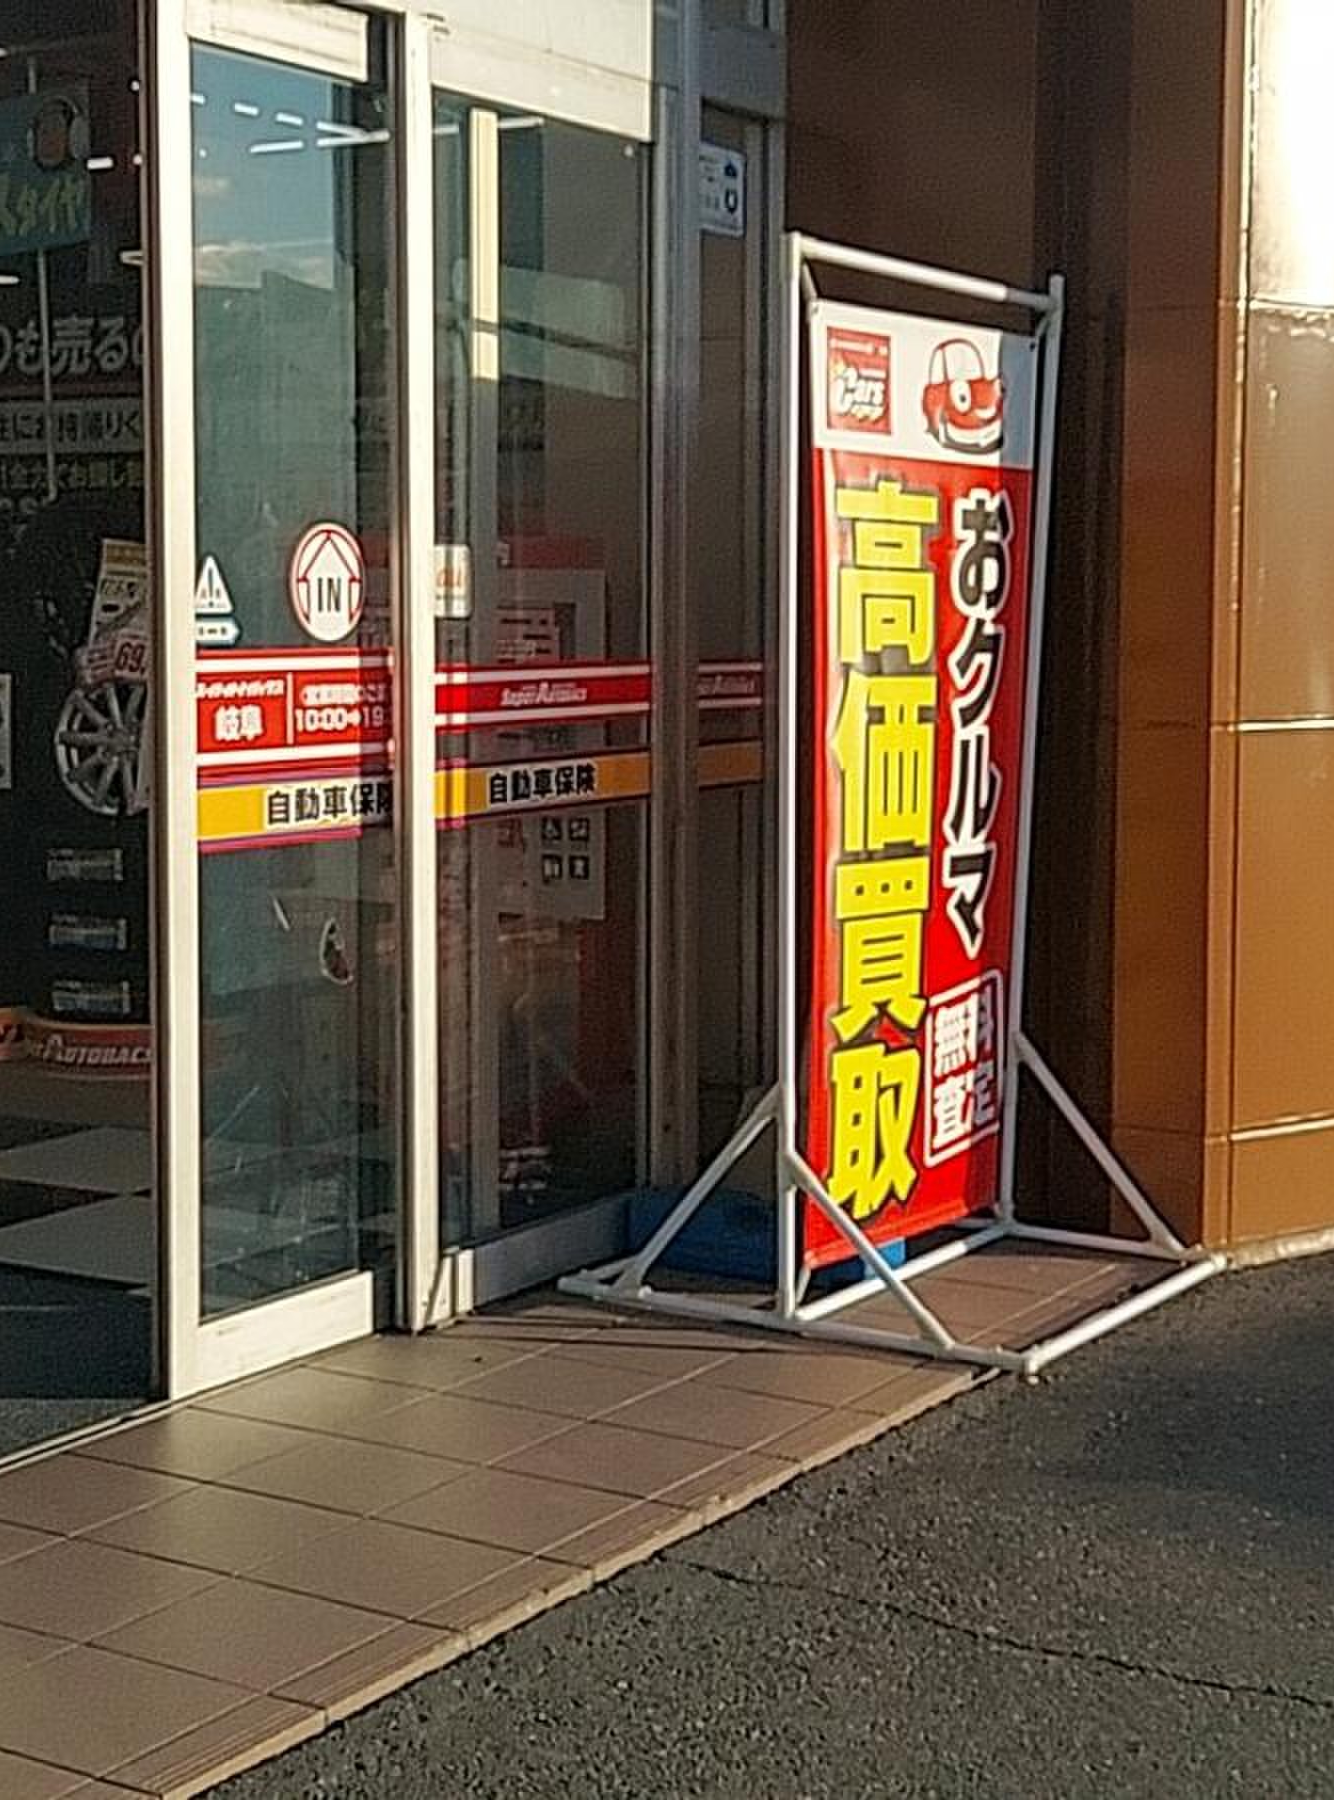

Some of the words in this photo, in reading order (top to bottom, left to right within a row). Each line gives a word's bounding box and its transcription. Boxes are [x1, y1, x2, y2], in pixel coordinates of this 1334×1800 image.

[317, 576, 341, 613] IN
[942, 488, 1012, 960] おクルマ
[488, 764, 597, 805] 自動車保険
[827, 478, 940, 1221] 高価買取
[932, 1059, 996, 1150] 査定
